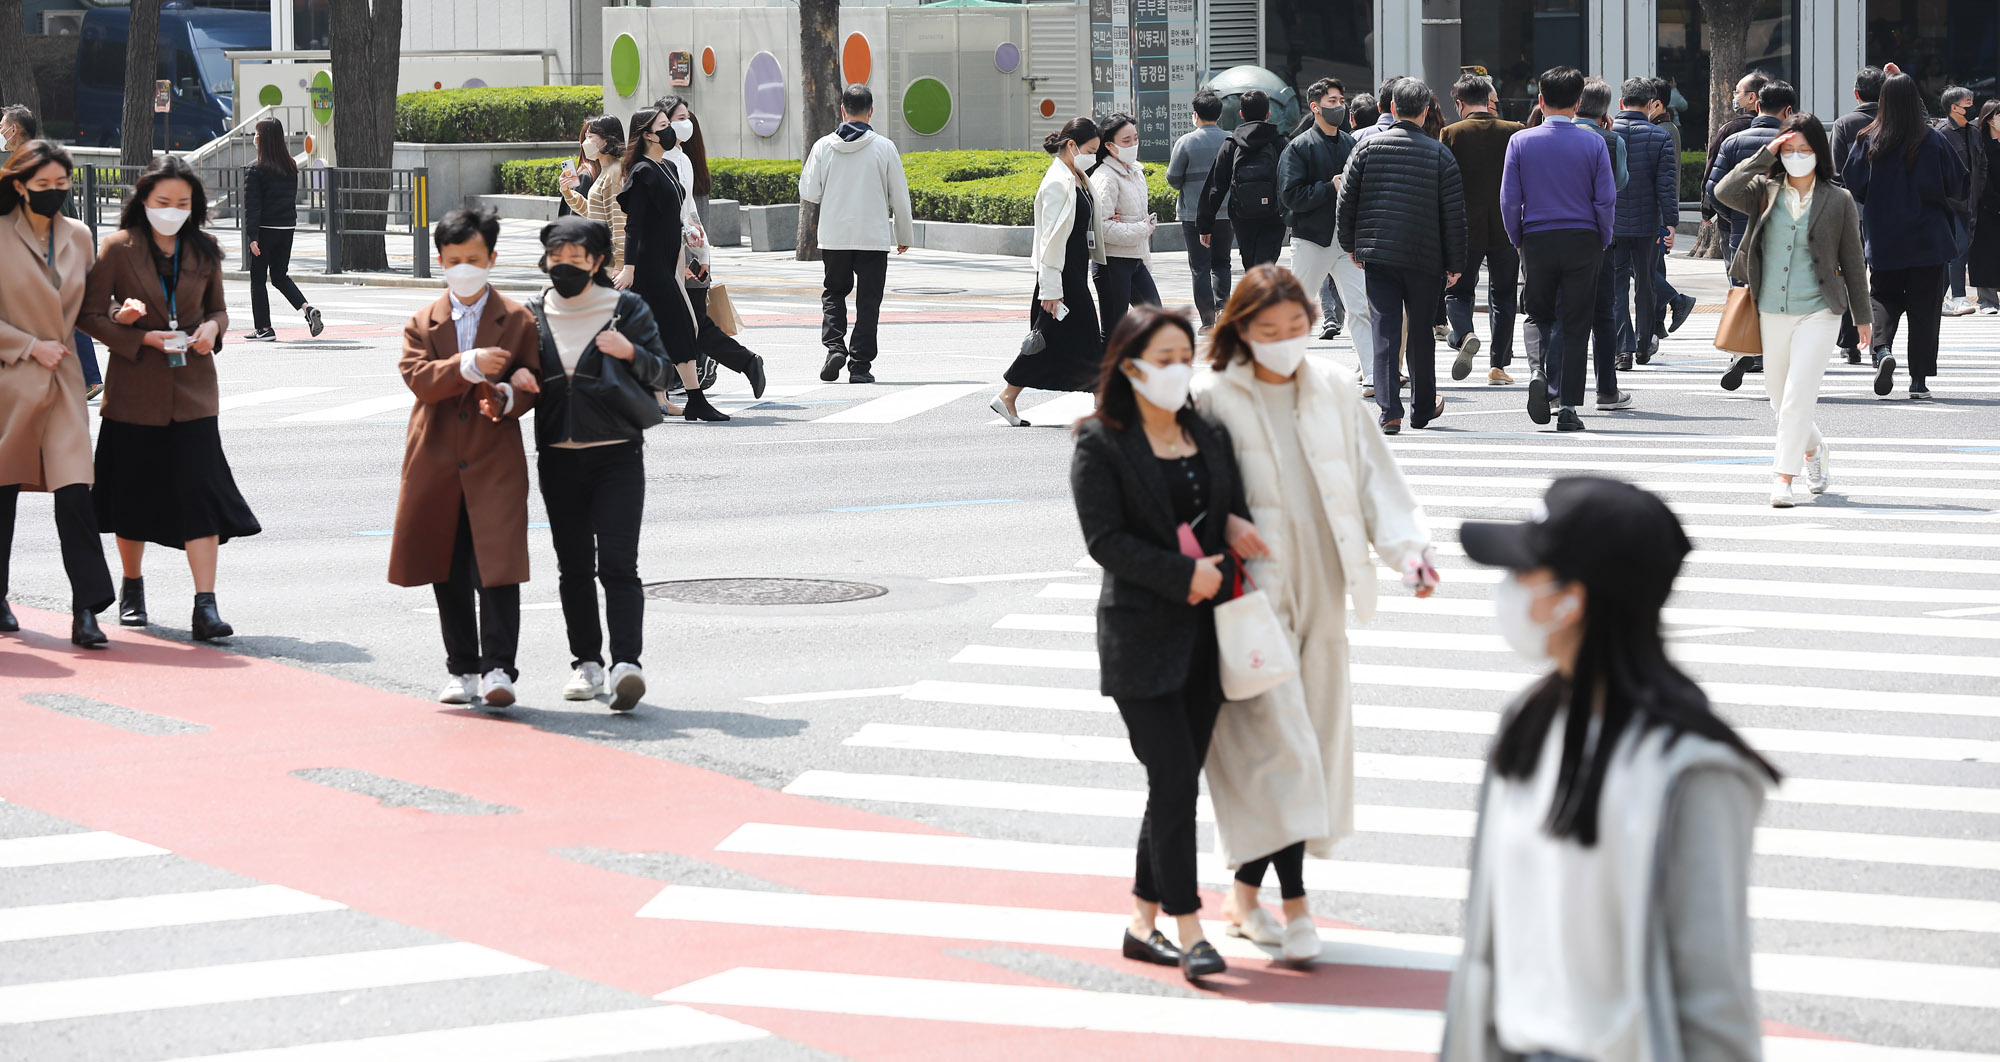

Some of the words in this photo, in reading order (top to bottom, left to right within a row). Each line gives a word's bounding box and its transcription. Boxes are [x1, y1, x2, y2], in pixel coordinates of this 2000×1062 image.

[1137, 0, 1166, 16] 두부촌
[1138, 30, 1167, 48] 안동국시
[1139, 65, 1167, 83] 동경암
[1171, 103, 1188, 111] 한정식
[1140, 139, 1169, 147] 722-9462
